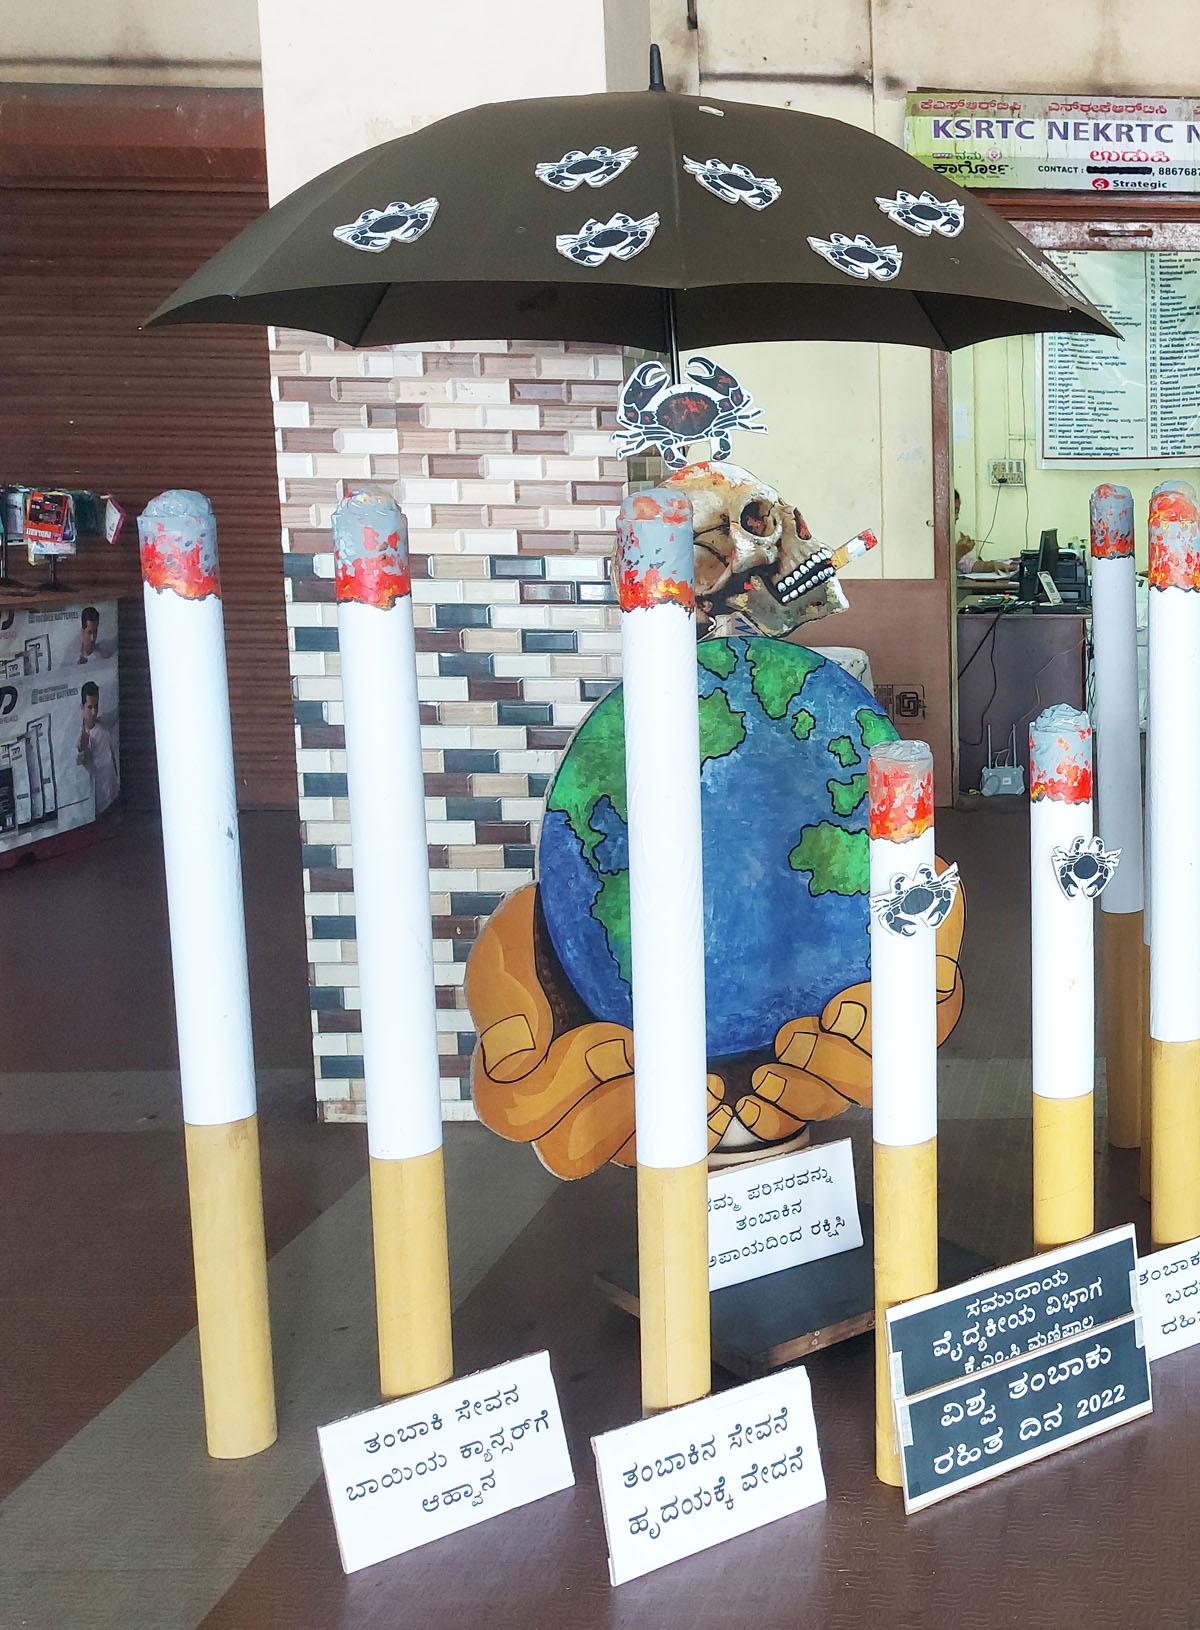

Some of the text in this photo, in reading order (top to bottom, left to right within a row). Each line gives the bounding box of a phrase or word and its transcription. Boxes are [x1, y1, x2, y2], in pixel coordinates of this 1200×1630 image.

[932, 119, 1035, 140] KSRTC
[1047, 121, 1174, 143] NEKRTC
[1038, 165, 1079, 174] CONTACT
[1089, 149, 1171, 163] ಉಡುಪಿ
[1112, 179, 1168, 190] Strategic
[747, 1166, 833, 1200] ಪರಿಸರವನ್ನು
[735, 1200, 802, 1231] ತಂಬಾಕಿನ
[811, 1215, 846, 1238] ರಕ್ಷಿಸಿ
[965, 1269, 1069, 1319] ಸಮುದಾಯ
[932, 1276, 1103, 1362] ವೈದ್ಯಕೀಯ ವಿಭಾಗ
[1027, 1315, 1094, 1351] ಮಣಿಪಾಲ
[940, 1343, 1112, 1428] ವಿಶ್ವ ತಂಬಾಕು
[364, 1384, 520, 1454] ತಂಬಾಕಿ ಸೇವನ
[933, 1383, 1126, 1475] ರಹಿತ ದಿನ 2022
[622, 1407, 788, 1489] ತಂಬಾಕಿನ ಸೇವನೆ
[346, 1452, 447, 1502] ಬಾಯಿಯ
[422, 1469, 496, 1513] ಆಹ್ವಾನ
[628, 1446, 804, 1540] ಹೃದಯಕ್ಕೆ ವೇದನೆ
